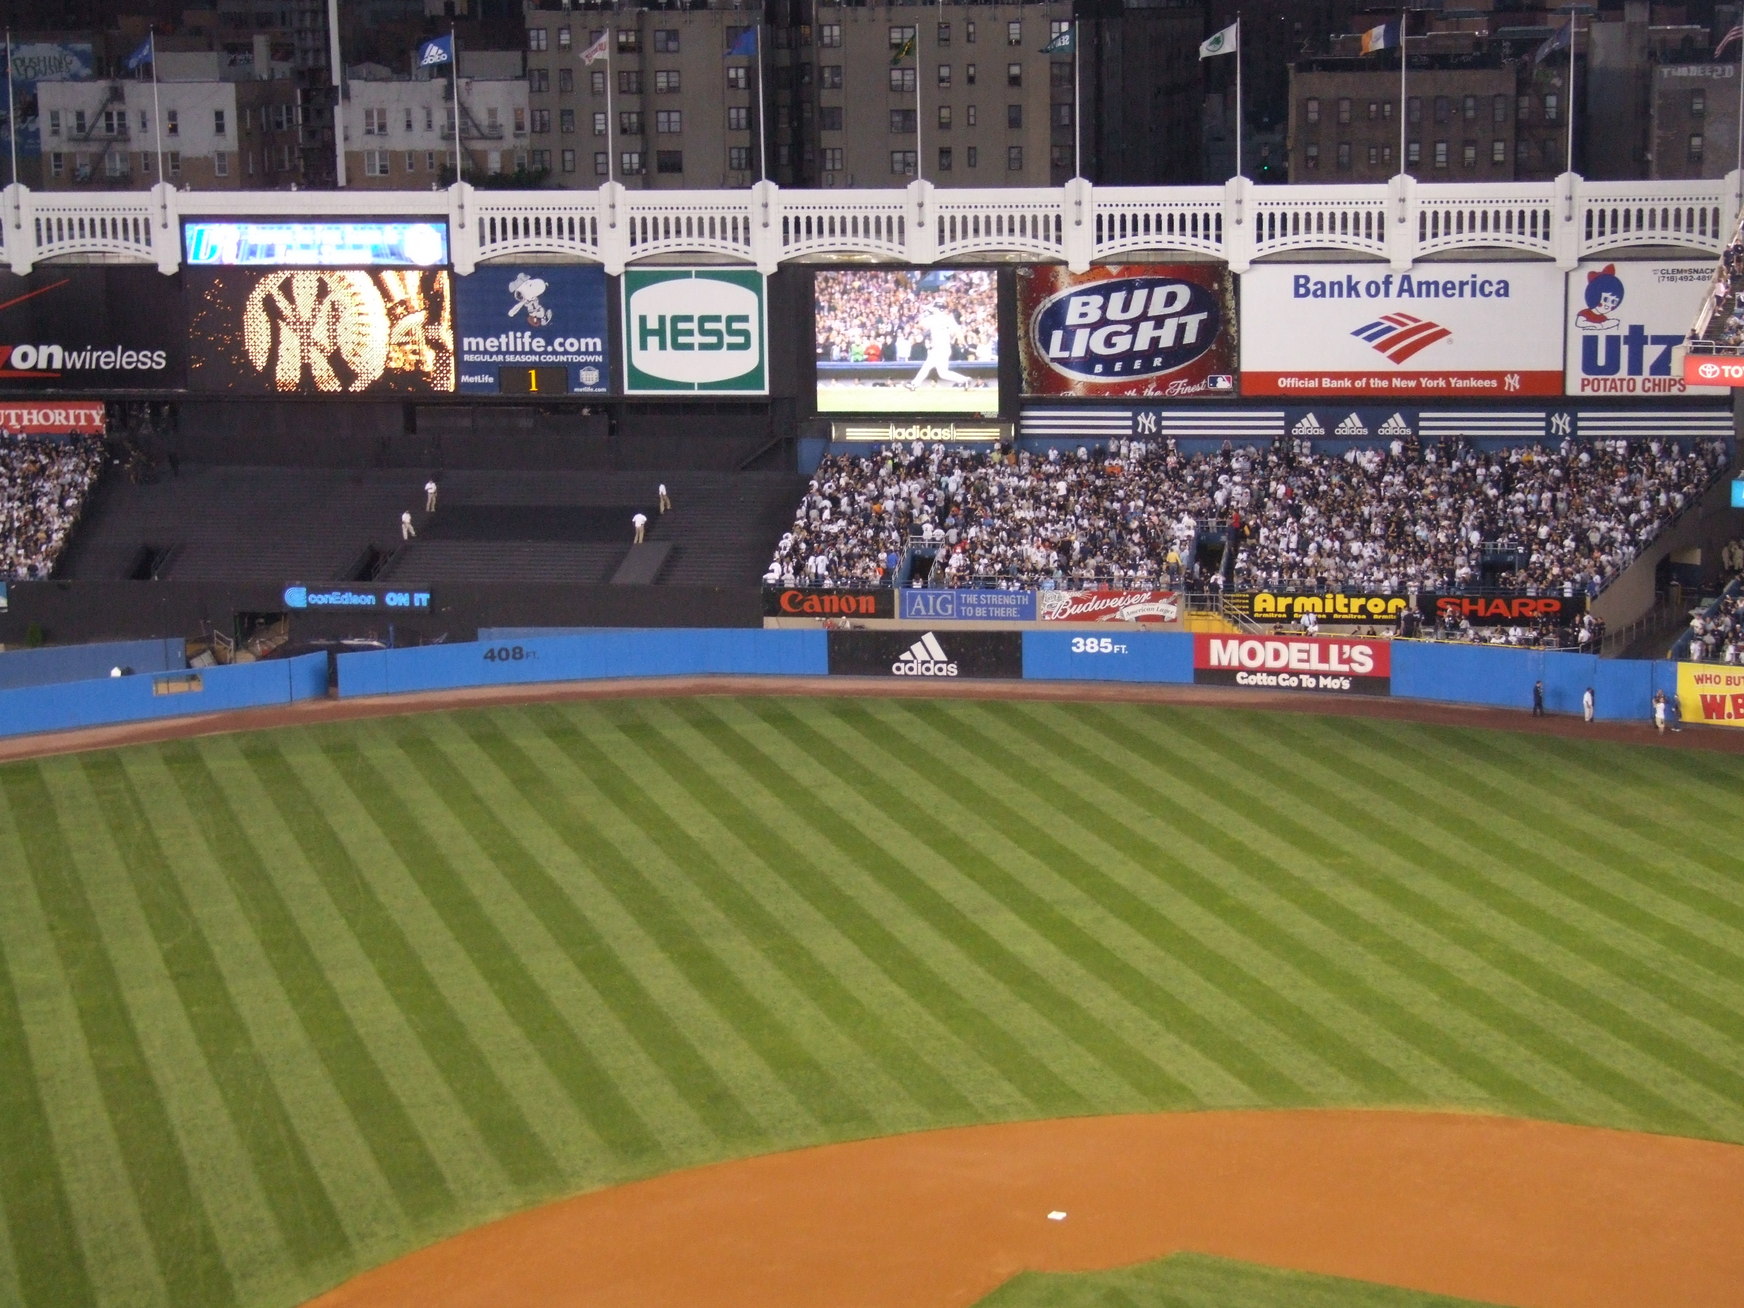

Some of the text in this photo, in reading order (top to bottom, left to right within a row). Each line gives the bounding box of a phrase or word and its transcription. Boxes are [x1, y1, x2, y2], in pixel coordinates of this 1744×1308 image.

[1293, 273, 1510, 299] Bank of America
[1065, 284, 1191, 326] BUD
[638, 314, 752, 351] HESS
[1048, 312, 1208, 359] LIGHT
[462, 331, 602, 353] metlife.com
[64, 344, 167, 370] wireless
[464, 354, 603, 362] REGULAR SEASON COUNTDOWN
[1094, 357, 1162, 374] BEER
[461, 374, 495, 383] MetLife
[528, 369, 538, 391] 1
[1721, 365, 1744, 378] TO
[1277, 377, 1319, 388] Official
[1322, 377, 1352, 388] Bank
[1354, 377, 1366, 388] of
[1369, 377, 1389, 388] the
[1391, 377, 1416, 388] New
[1419, 377, 1446, 388] York
[1448, 377, 1498, 388] Yankees
[1581, 377, 1687, 393] POTATO CHIPS
[893, 424, 951, 440] adidas
[1291, 426, 1326, 436] adidas
[1334, 426, 1369, 436] adidas
[1377, 426, 1412, 436] adidas
[385, 592, 410, 606] ON
[413, 593, 430, 606] IT
[779, 590, 876, 614] Canon
[910, 594, 954, 616] AIG
[960, 593, 1029, 605] THE STRENGTH
[1052, 591, 1152, 620] Budweiser
[1254, 593, 1406, 613] Armitron
[1436, 597, 1562, 618] SHARP
[960, 606, 973, 616] TO
[975, 606, 987, 616] BE
[484, 646, 524, 662] 408
[1071, 637, 1129, 654] 385 FT.
[1209, 639, 1374, 674] MODELL'S
[891, 659, 959, 676] adidas
[1236, 671, 1351, 690] Gotta Go To Mo's
[1694, 674, 1722, 685] WHO
